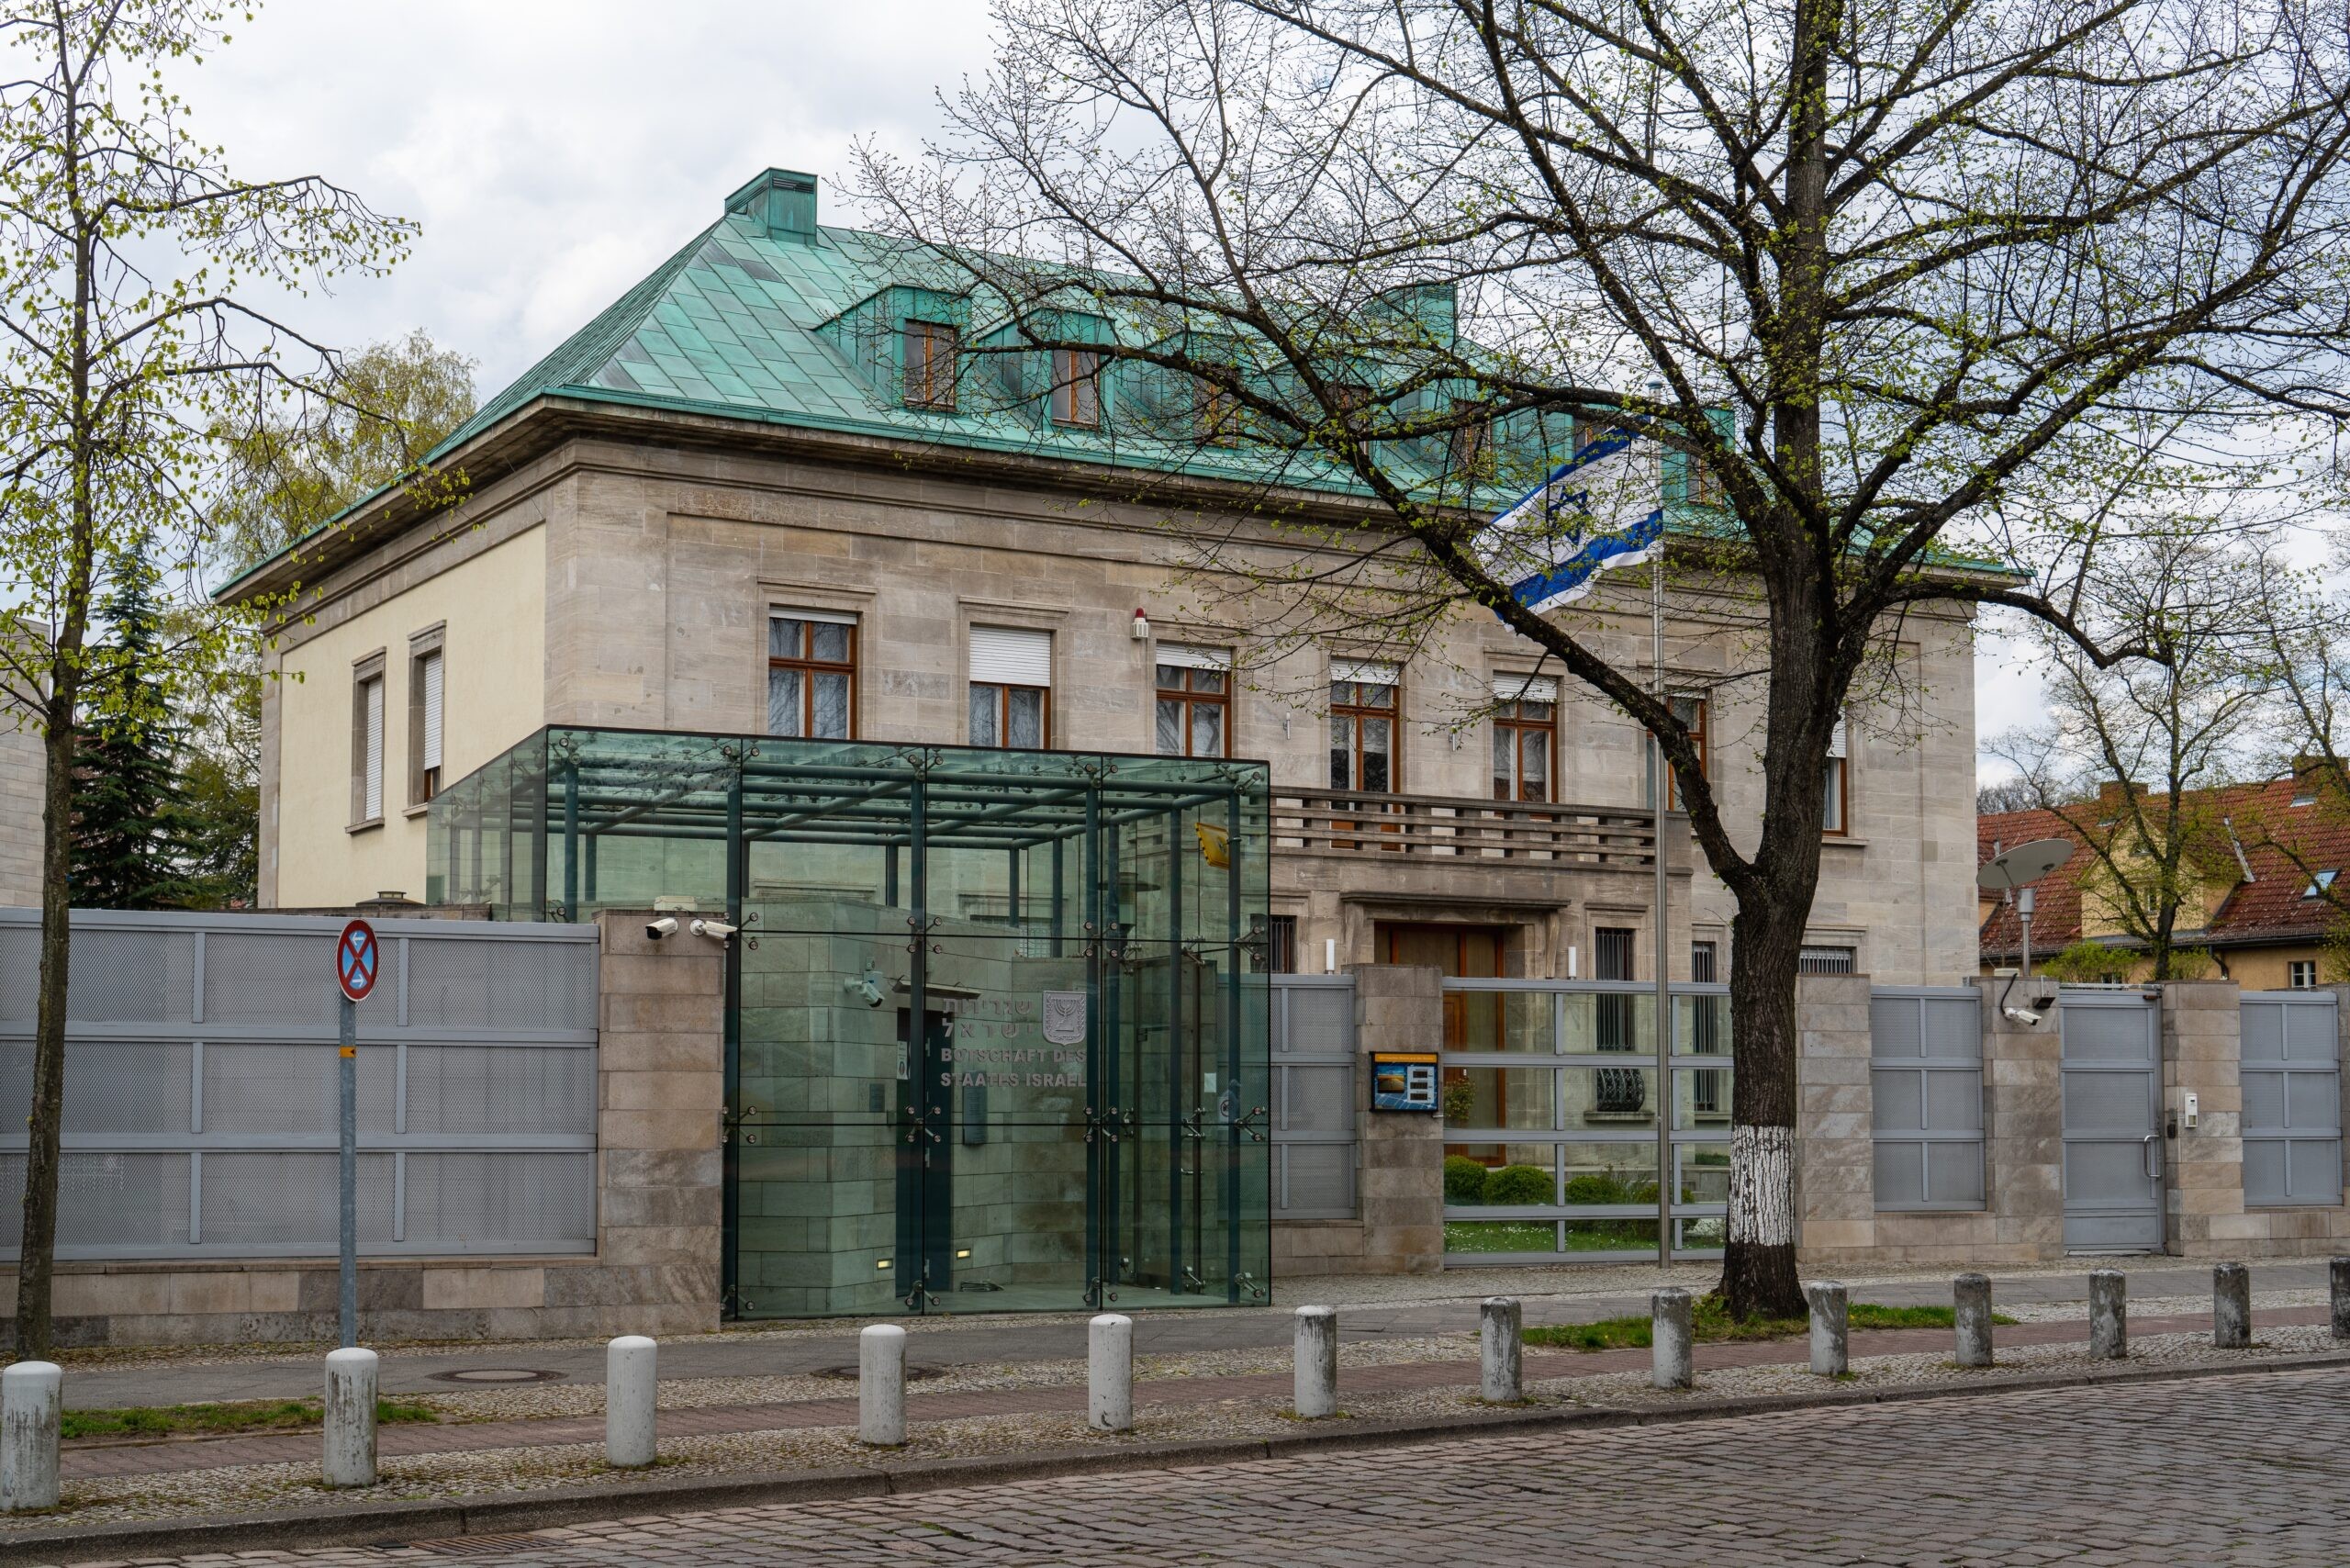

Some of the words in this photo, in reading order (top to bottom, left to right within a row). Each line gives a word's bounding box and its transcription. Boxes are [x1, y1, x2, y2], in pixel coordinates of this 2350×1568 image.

[942, 1018, 1033, 1038] ישראל
[941, 1047, 1047, 1063] BOTSCHAFT
[1053, 1048, 1087, 1063] DES
[941, 1072, 1019, 1088] STAATES
[1025, 1072, 1087, 1088] ISRAEL
